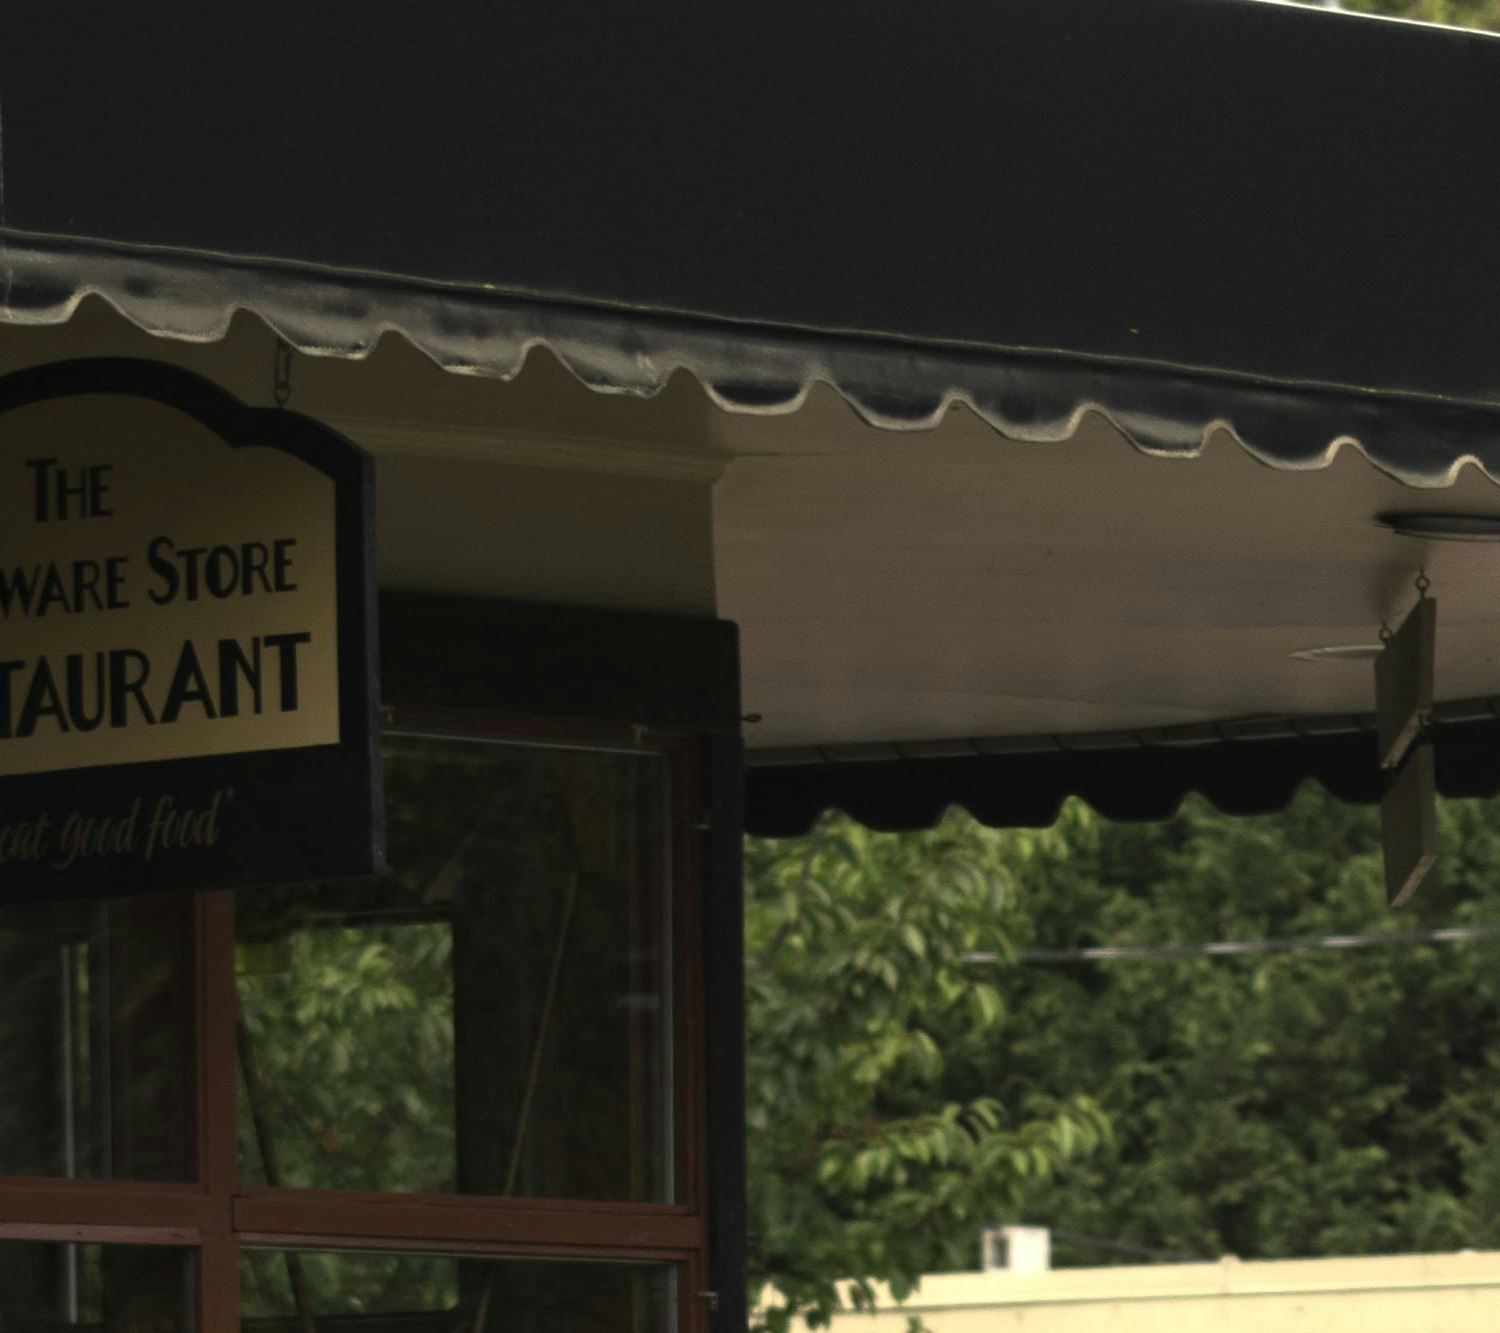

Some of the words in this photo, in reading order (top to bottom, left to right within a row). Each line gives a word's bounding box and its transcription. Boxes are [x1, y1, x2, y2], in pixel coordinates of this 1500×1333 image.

[25, 457, 113, 521] THE
[147, 537, 297, 605] STORE
[52, 797, 142, 872] good
